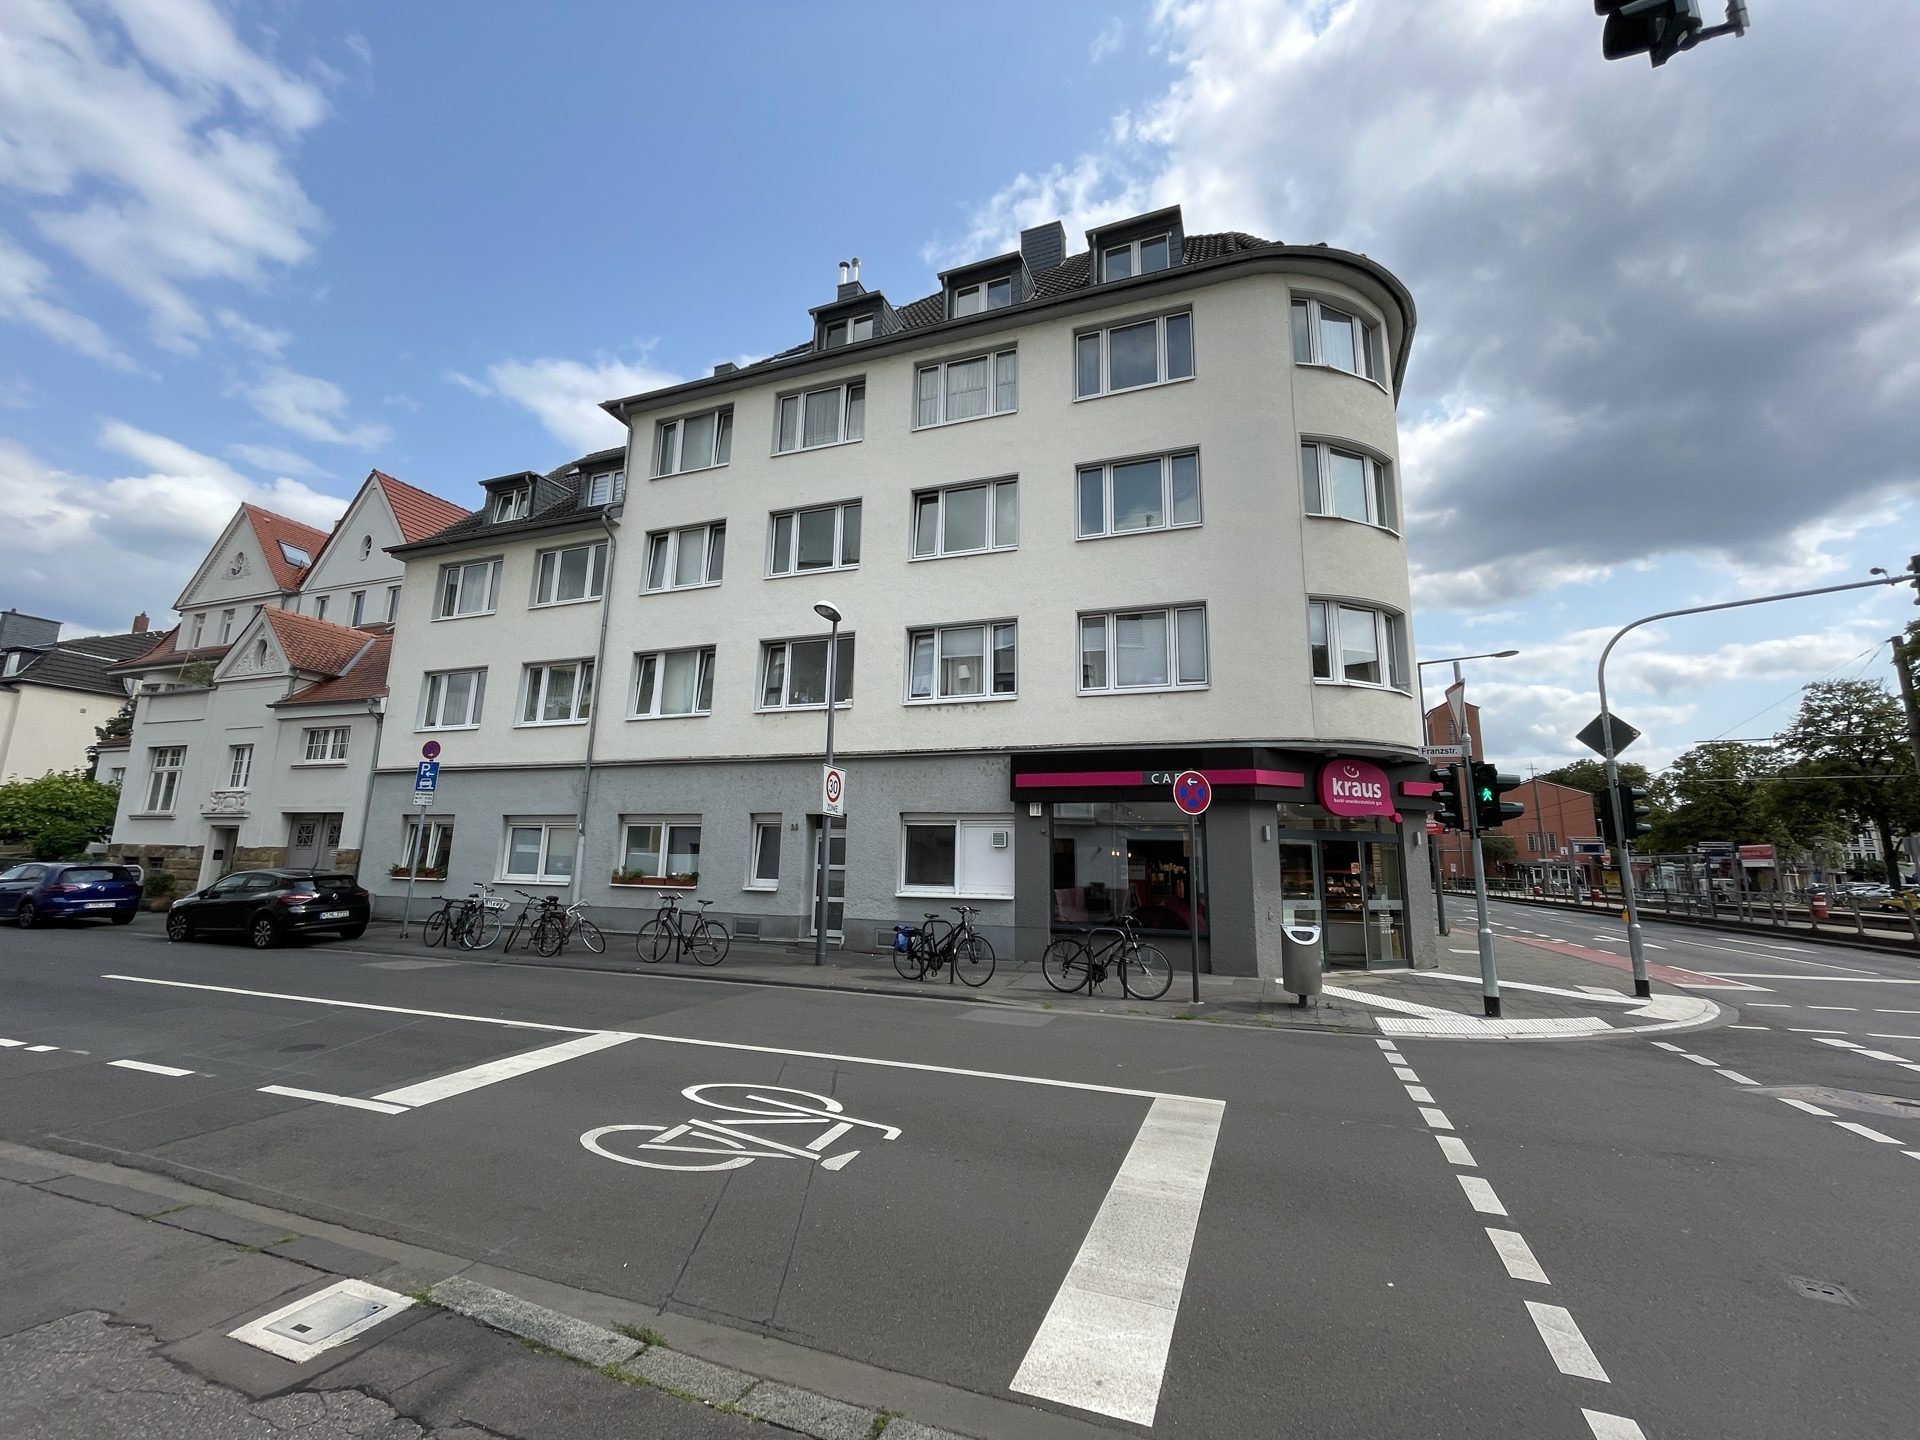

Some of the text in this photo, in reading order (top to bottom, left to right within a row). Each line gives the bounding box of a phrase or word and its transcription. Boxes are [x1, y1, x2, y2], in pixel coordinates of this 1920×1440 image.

[1421, 747, 1458, 755] Franzstr.
[420, 763, 431, 775] P
[828, 779, 838, 794] 30
[1332, 777, 1382, 798] kraus
[827, 803, 838, 813] ZONE
